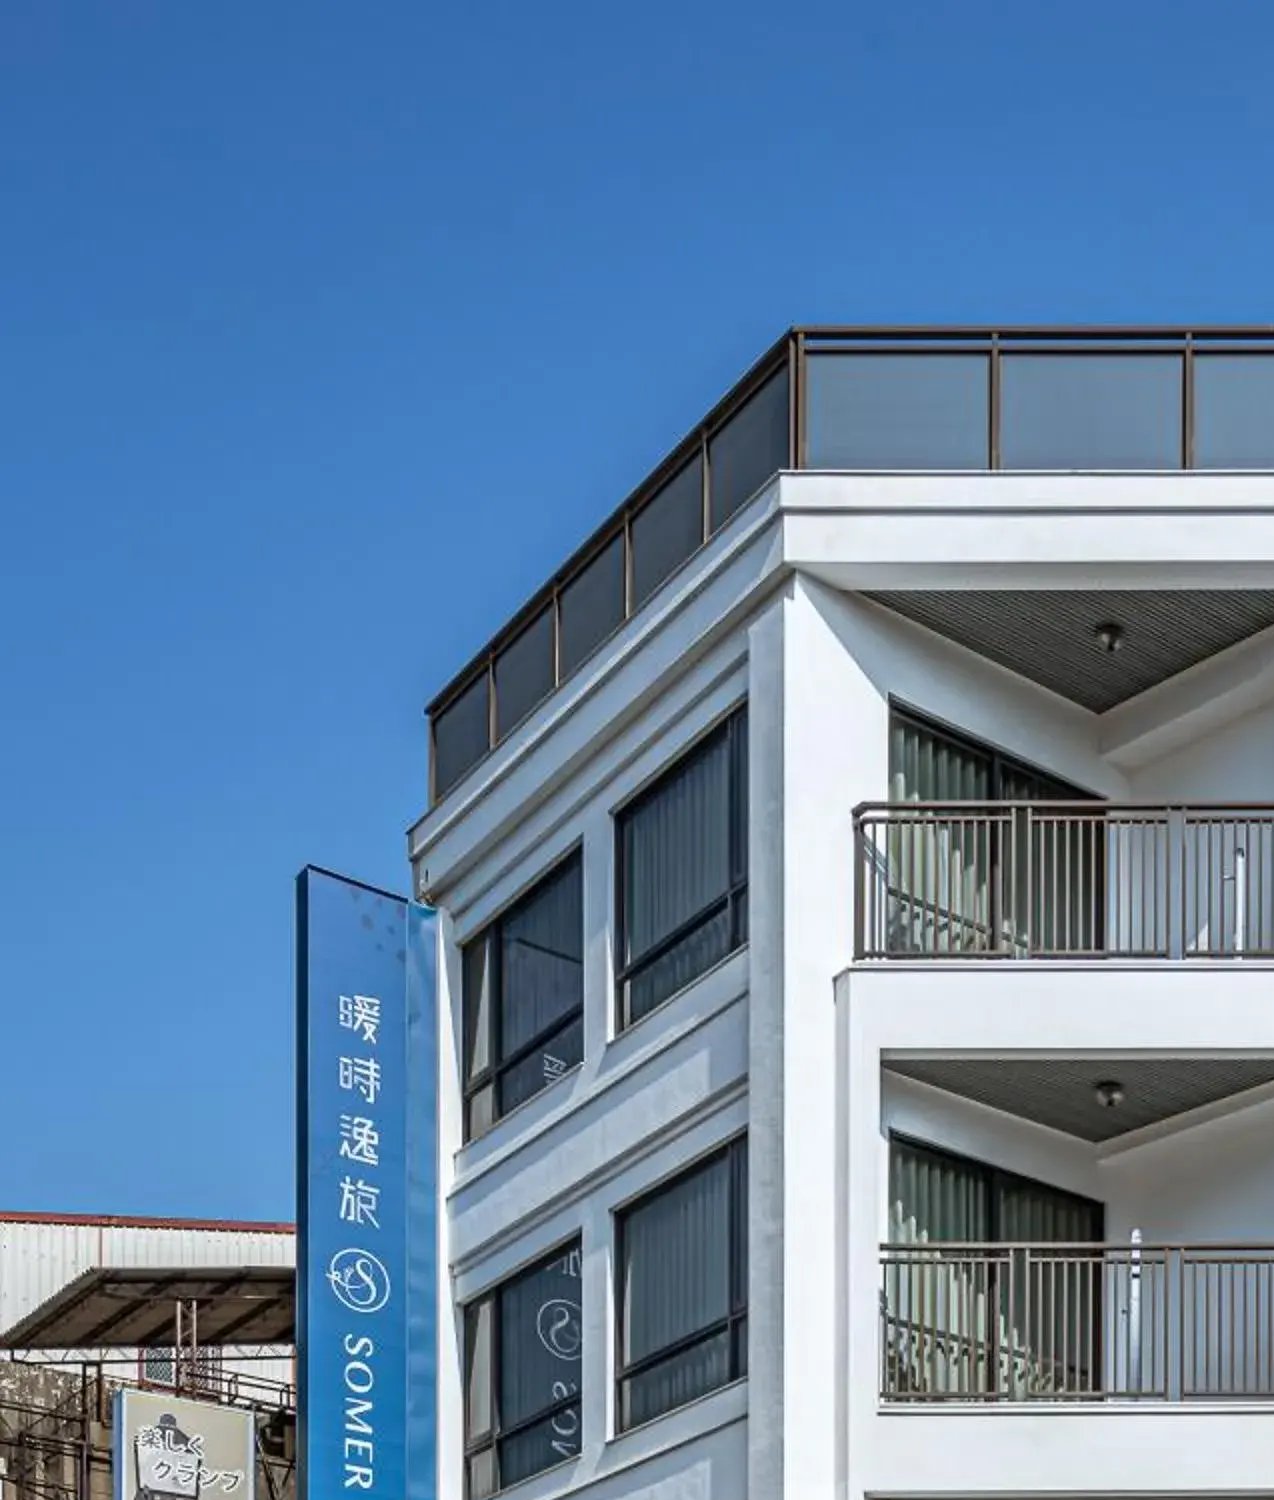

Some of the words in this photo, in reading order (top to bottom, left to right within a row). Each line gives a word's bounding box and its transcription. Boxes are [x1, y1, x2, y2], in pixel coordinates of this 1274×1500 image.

[338, 994, 382, 1229] 暖時逸旅
[345, 1333, 375, 1489] SOMER
